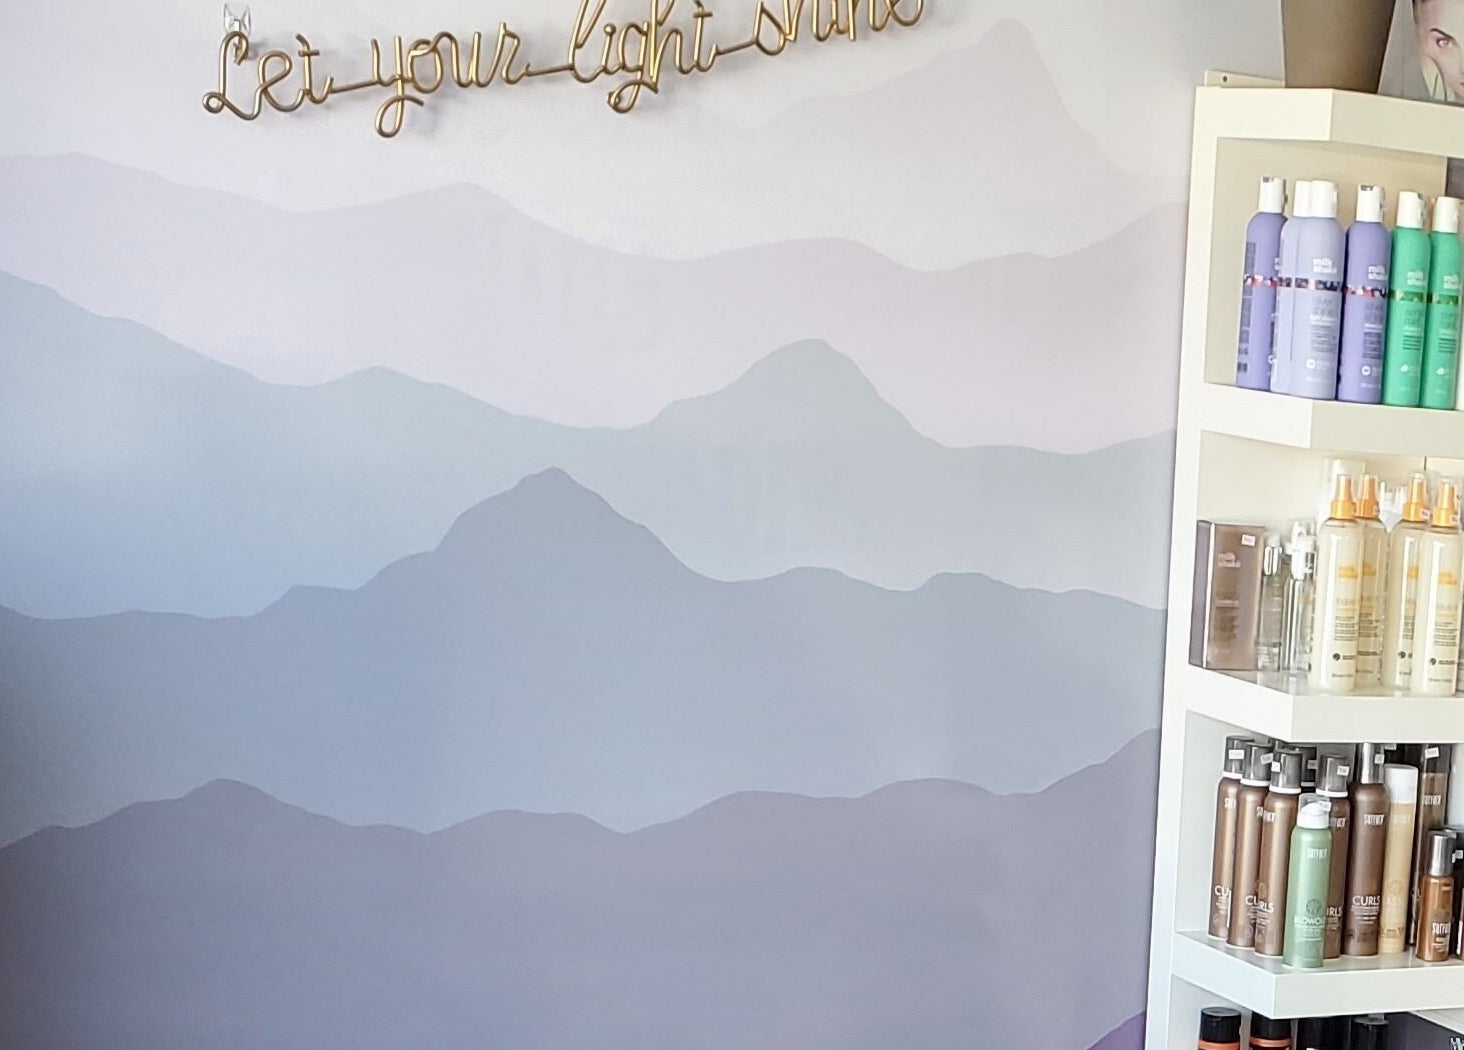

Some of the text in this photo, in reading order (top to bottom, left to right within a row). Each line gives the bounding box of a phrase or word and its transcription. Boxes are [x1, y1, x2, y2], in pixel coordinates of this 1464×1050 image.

[201, 31, 331, 121] Let
[371, 21, 528, 138] your
[568, 0, 718, 113] light
[1352, 895, 1381, 906] CURLS
